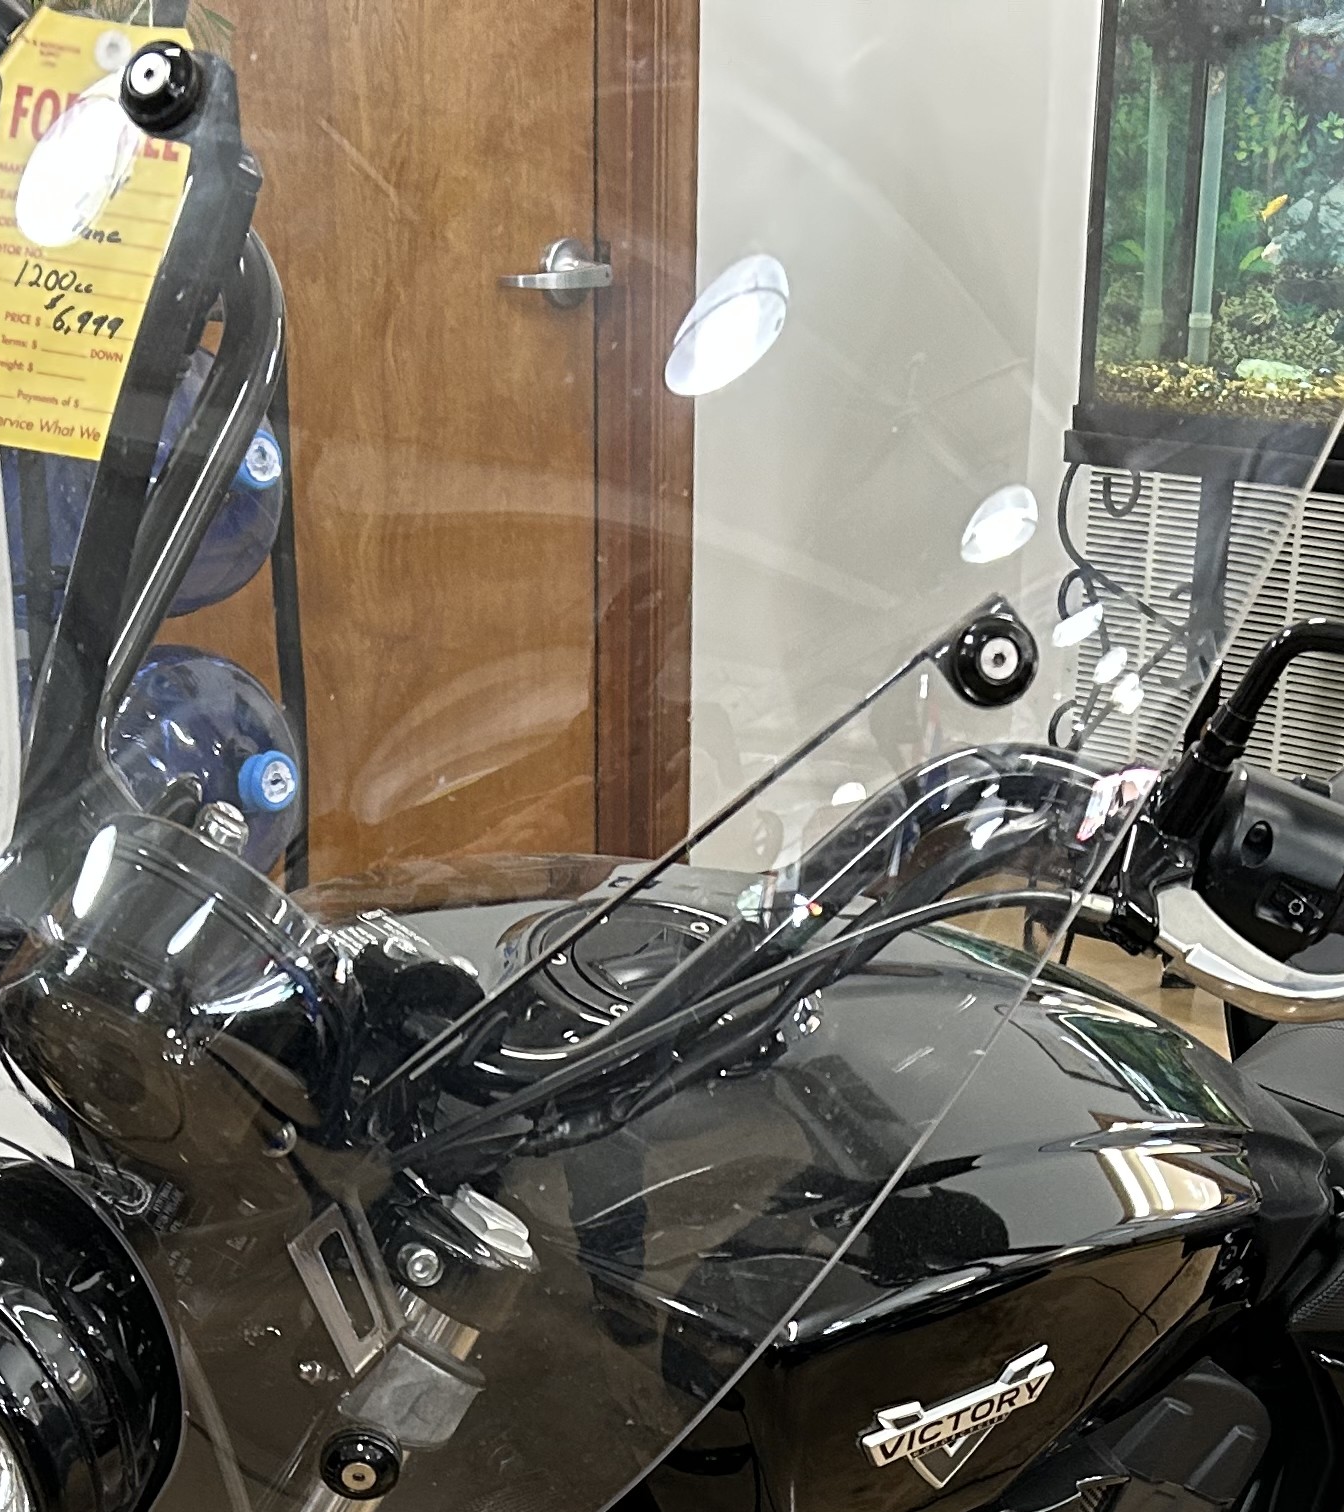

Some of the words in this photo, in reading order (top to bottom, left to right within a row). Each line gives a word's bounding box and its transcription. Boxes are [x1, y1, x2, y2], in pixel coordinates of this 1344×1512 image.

[4, 310, 32, 325] PRICE
[90, 348, 124, 363] DOWN
[17, 388, 59, 405] Payments
[40, 418, 75, 438] What
[80, 427, 101, 442] We
[879, 1375, 1047, 1461] VICTORY
